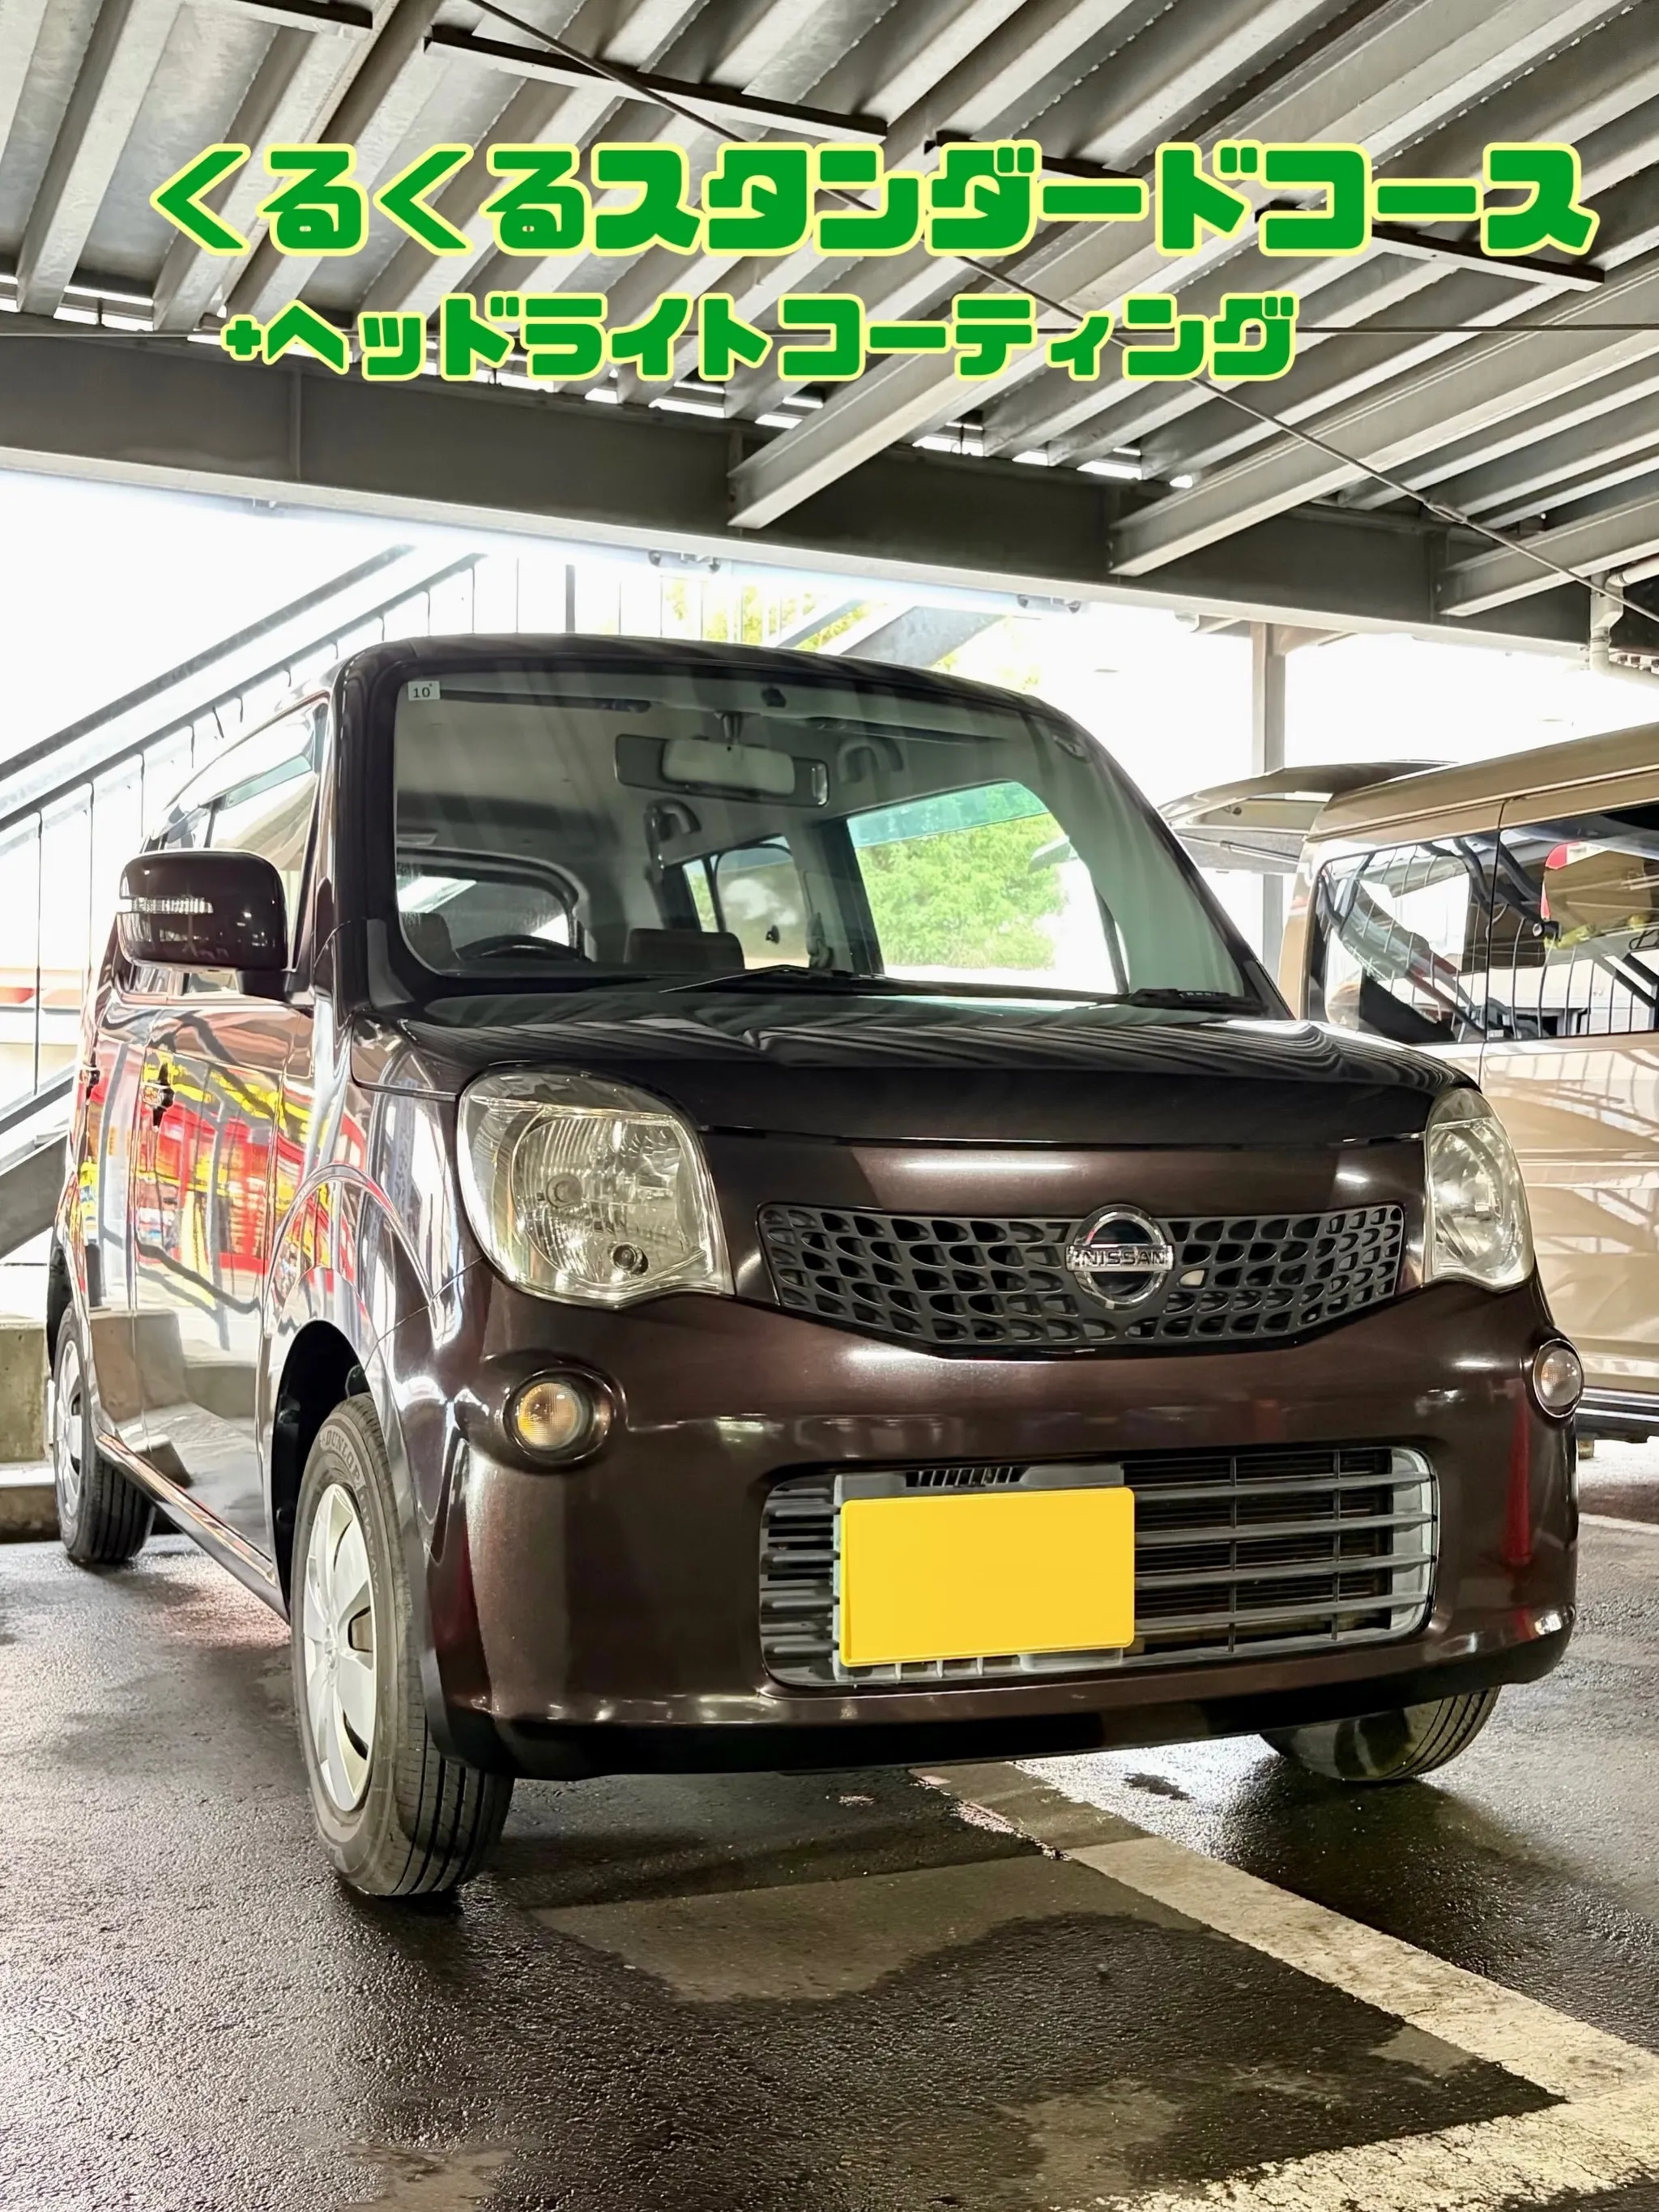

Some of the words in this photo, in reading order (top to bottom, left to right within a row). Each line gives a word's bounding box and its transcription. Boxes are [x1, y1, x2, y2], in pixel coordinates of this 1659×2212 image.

[412, 686, 431, 698] 10
[1083, 1249, 1166, 1266] NISSAN
[325, 1429, 361, 1482] DUNLOP
